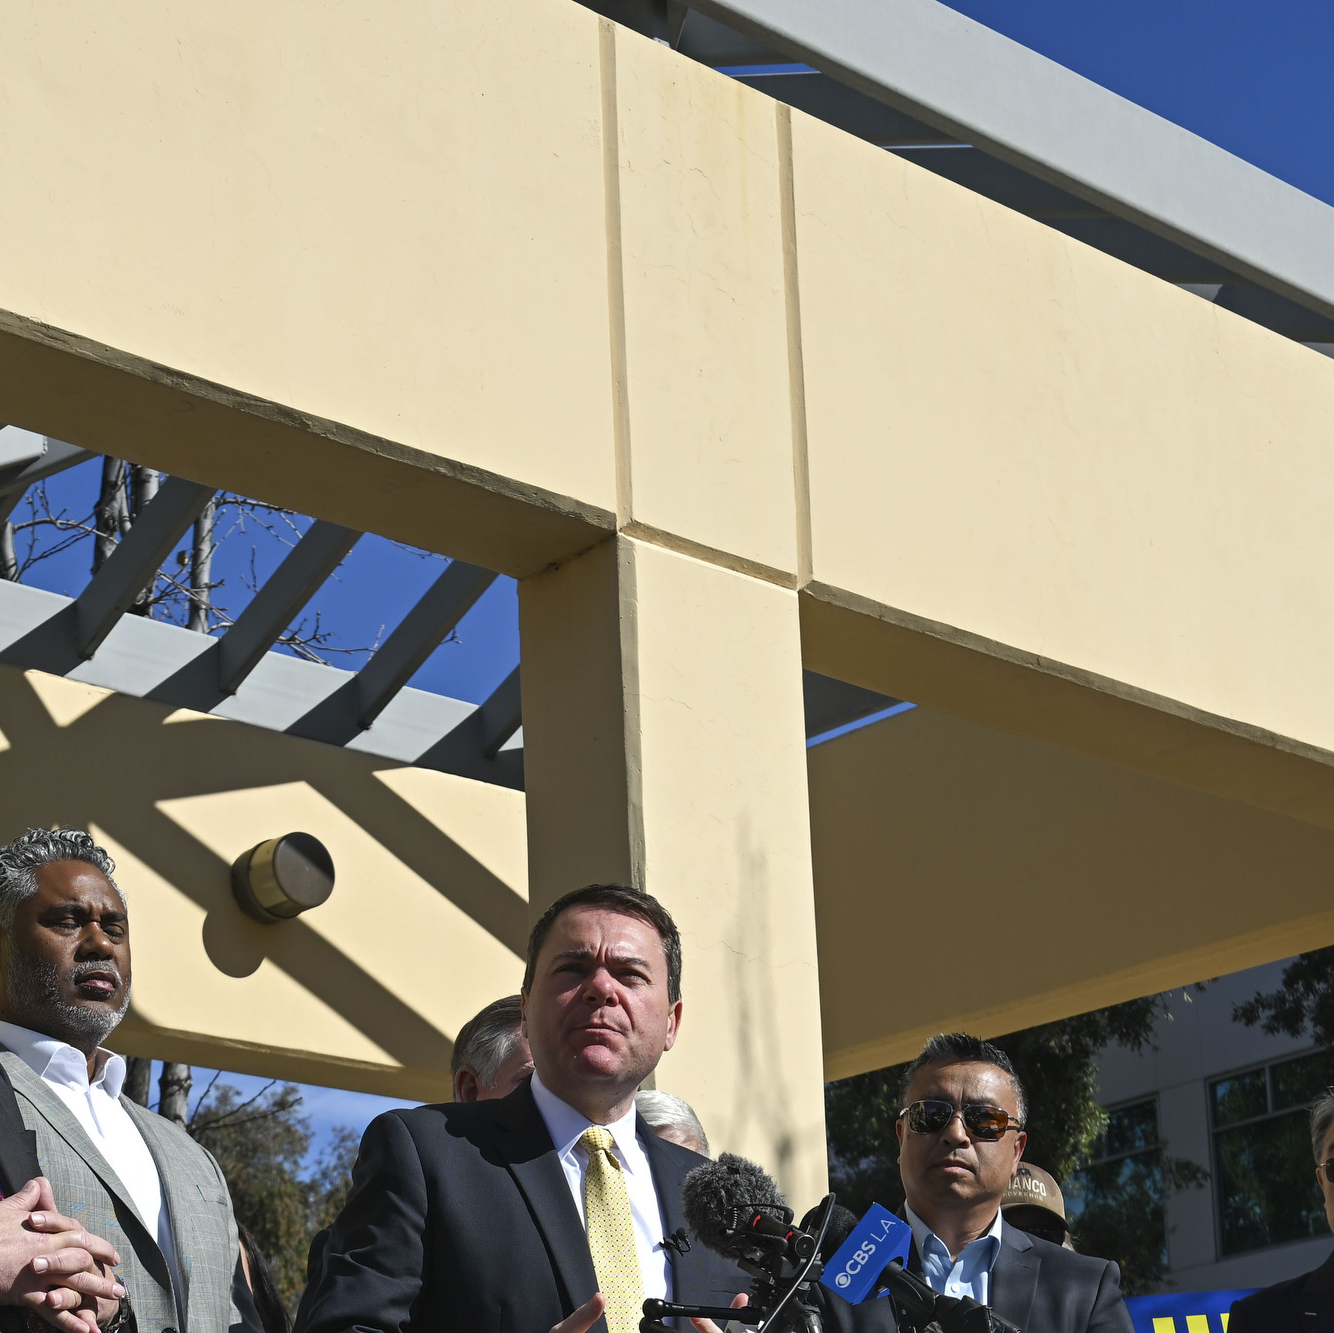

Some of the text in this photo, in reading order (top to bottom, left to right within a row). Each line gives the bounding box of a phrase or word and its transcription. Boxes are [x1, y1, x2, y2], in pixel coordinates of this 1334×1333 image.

[1007, 1176, 1047, 1197] IANCO
[845, 1217, 897, 1276] CBS LA
